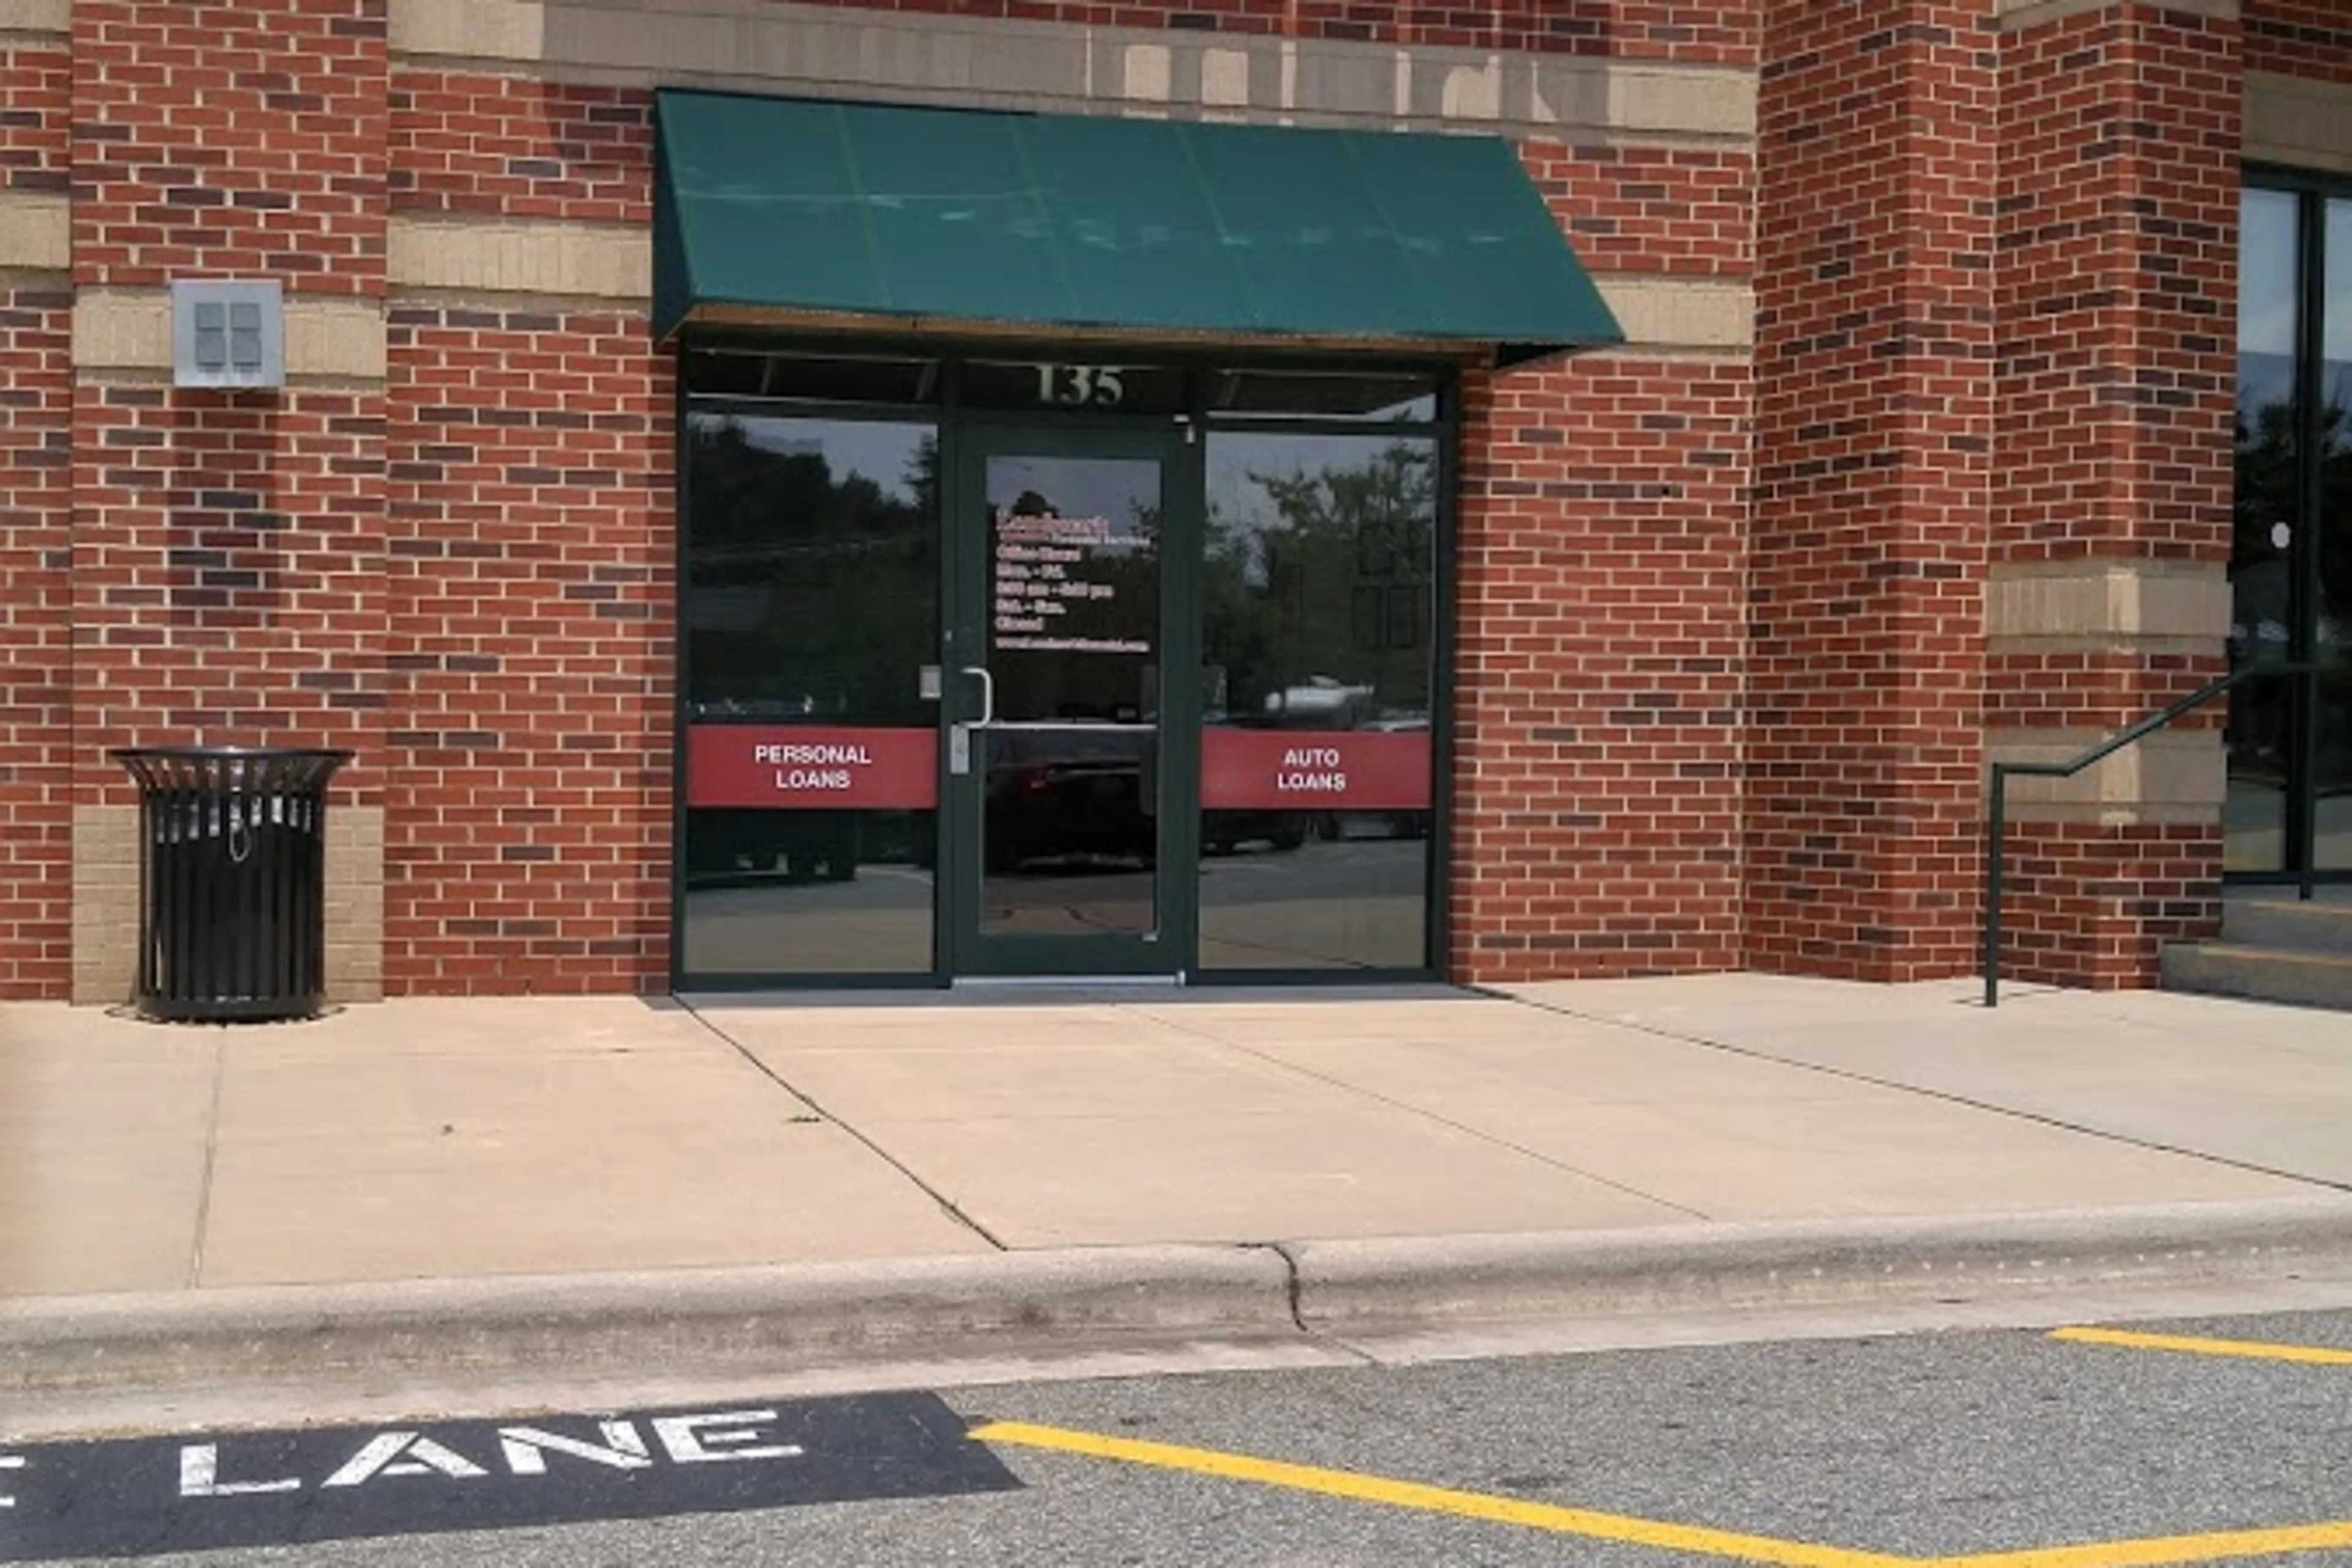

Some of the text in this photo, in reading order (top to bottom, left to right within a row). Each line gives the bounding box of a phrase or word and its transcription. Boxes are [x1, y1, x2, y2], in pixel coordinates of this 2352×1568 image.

[1036, 365, 1123, 404] 135
[755, 745, 872, 764] PERSONAL
[1284, 748, 1340, 767] AUTO
[776, 770, 851, 789] LOANS
[1278, 773, 1346, 791] LOANS
[180, 1410, 804, 1496] LANE
